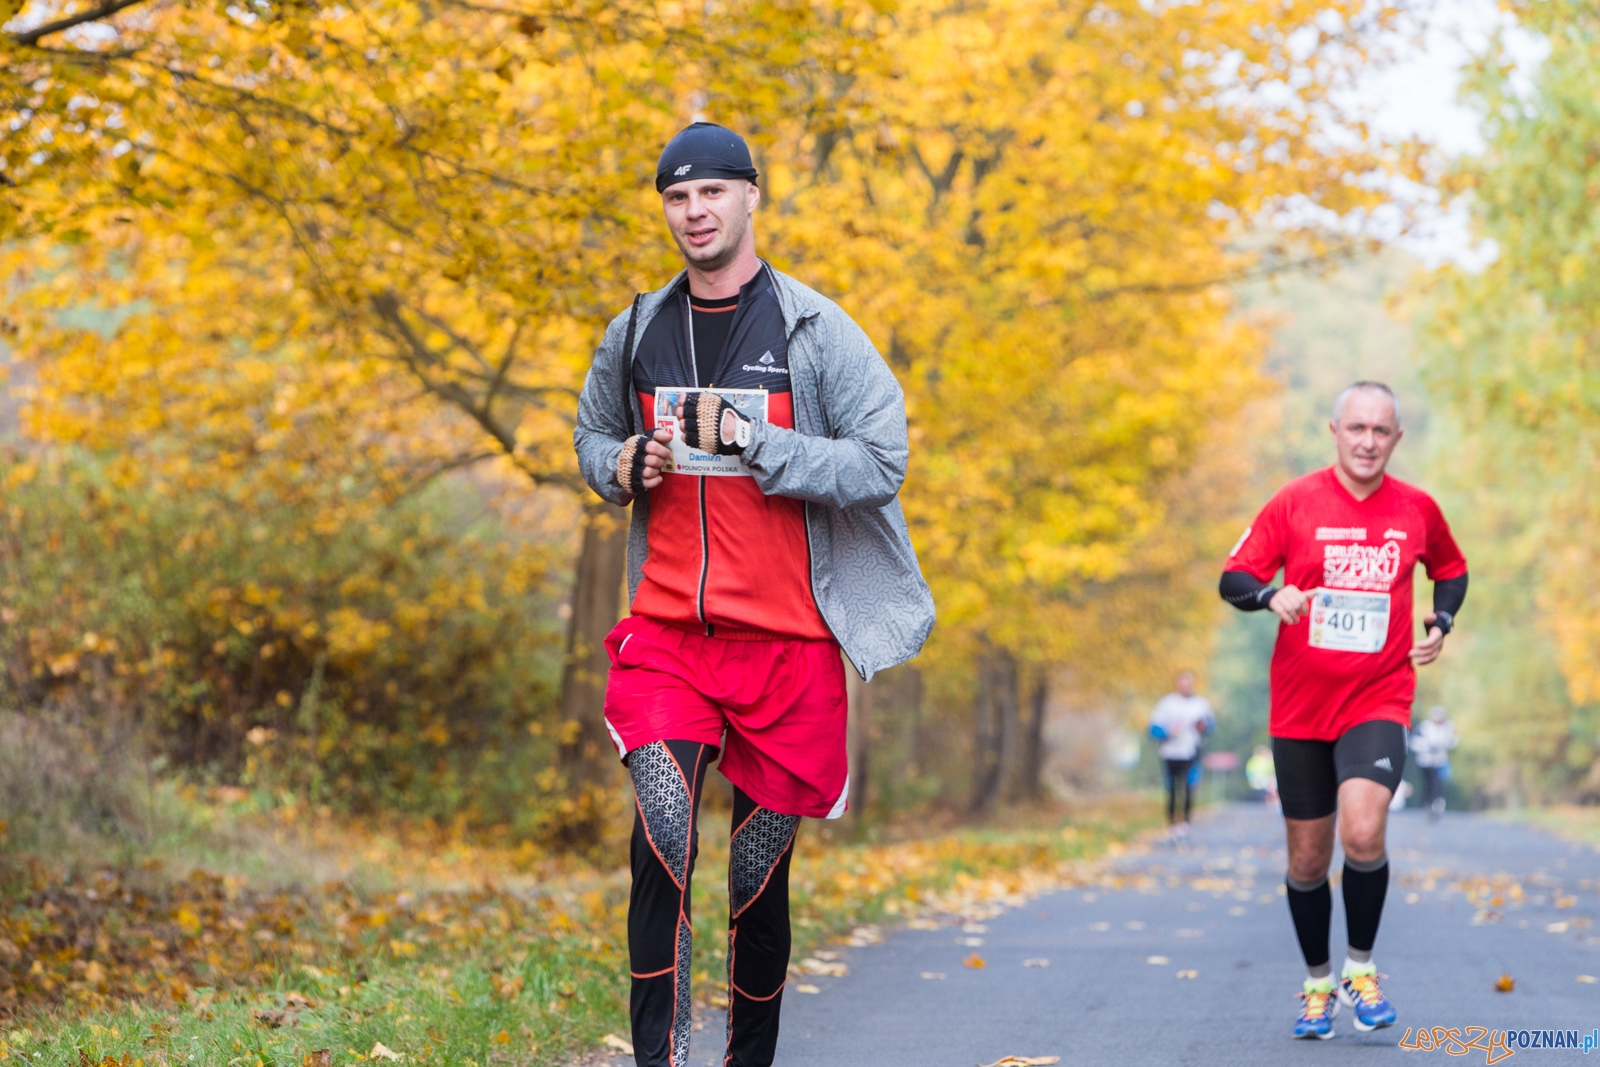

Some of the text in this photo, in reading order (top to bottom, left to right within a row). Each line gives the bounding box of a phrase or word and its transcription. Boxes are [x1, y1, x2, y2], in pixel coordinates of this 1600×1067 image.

[674, 164, 692, 176] 4F
[742, 364, 788, 374] Cycling Sports
[681, 464, 710, 472] POLINOVA
[1324, 557, 1399, 578] SZPIKU
[1327, 612, 1366, 632] 401
